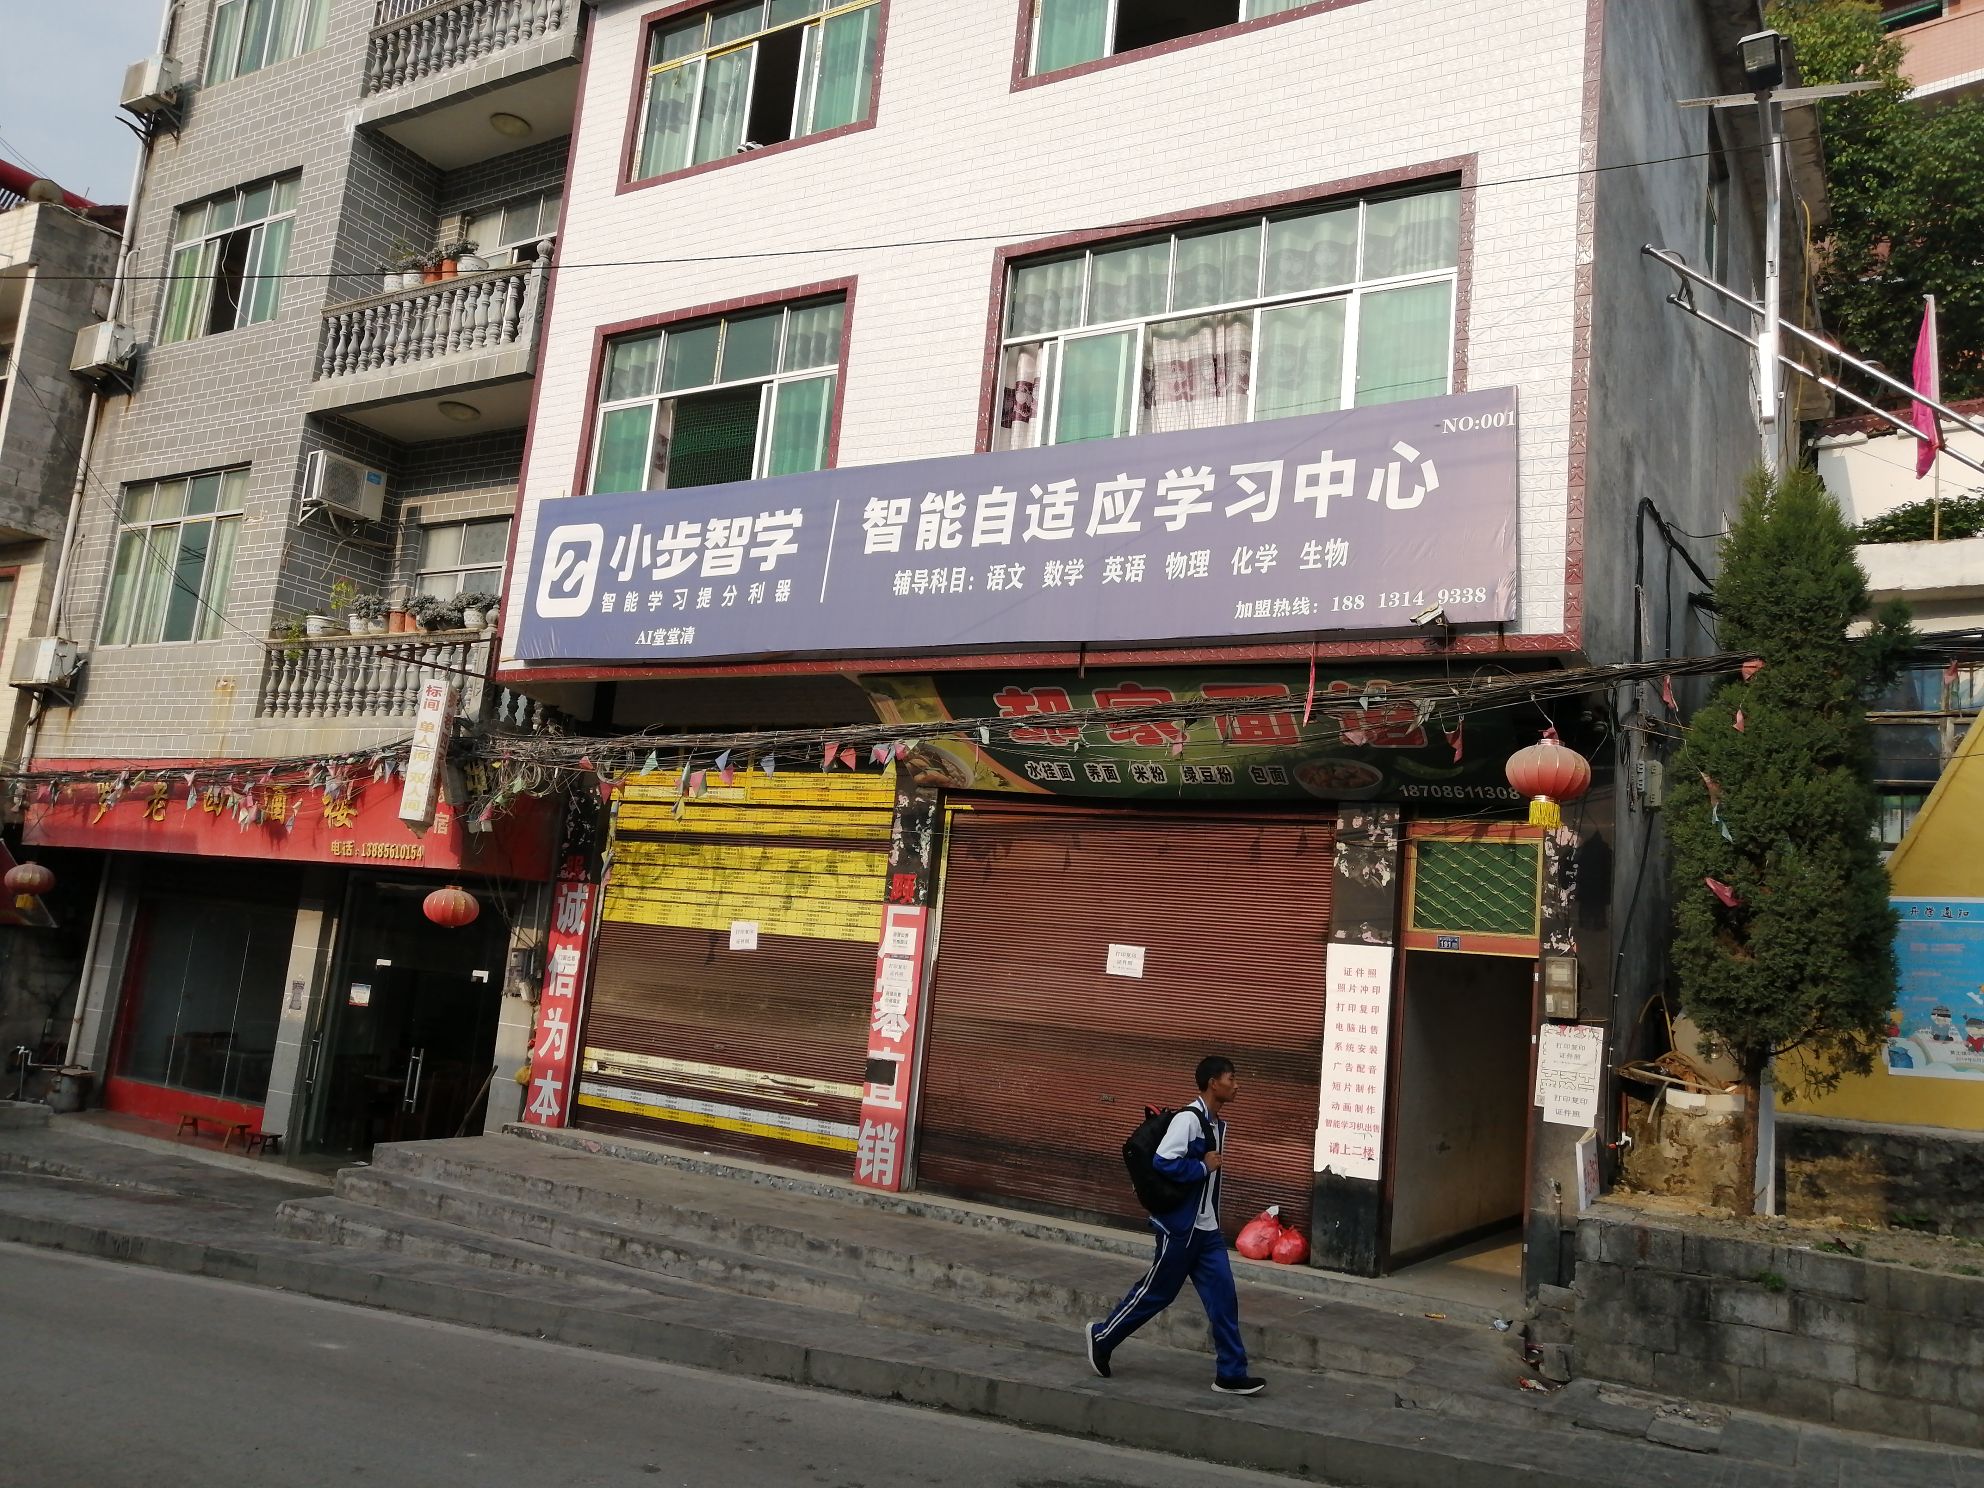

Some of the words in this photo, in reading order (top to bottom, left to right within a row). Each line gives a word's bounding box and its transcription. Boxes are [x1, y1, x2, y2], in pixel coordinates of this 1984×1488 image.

[1442, 411, 1515, 434] NO:001
[861, 440, 1440, 555] 智能自适应学习中心
[608, 508, 804, 582] 小步智学
[1042, 558, 1085, 588] 数学
[1102, 553, 1147, 584] 英语
[1165, 549, 1211, 580] 物理
[1230, 543, 1278, 576] 化学
[1299, 537, 1350, 570] 生物
[601, 578, 792, 614] 智能学习提分利器
[1378, 590, 1425, 608] 1314
[1436, 587, 1487, 606] 9338
[635, 626, 695, 647] AI堂堂清
[422, 684, 443, 712] 标间
[1132, 764, 1167, 784] 米粉
[1181, 765, 1234, 785] 绿豆粉
[1400, 784, 1520, 800] 18708611308
[1343, 966, 1377, 979] 证件照
[1336, 983, 1381, 996] 照片冲印
[529, 883, 590, 1125] 诚信为本
[1336, 1003, 1380, 1015] 打印复印
[1335, 1022, 1378, 1035] 电脑出售
[1334, 1042, 1378, 1055] 系统安装
[1333, 1062, 1377, 1075] 广告配音
[1332, 1081, 1376, 1095] 短片制作
[1331, 1101, 1376, 1115] 动画制作
[1325, 1118, 1380, 1134] 智能学习机出售
[1328, 1142, 1375, 1159] 请上二楼
